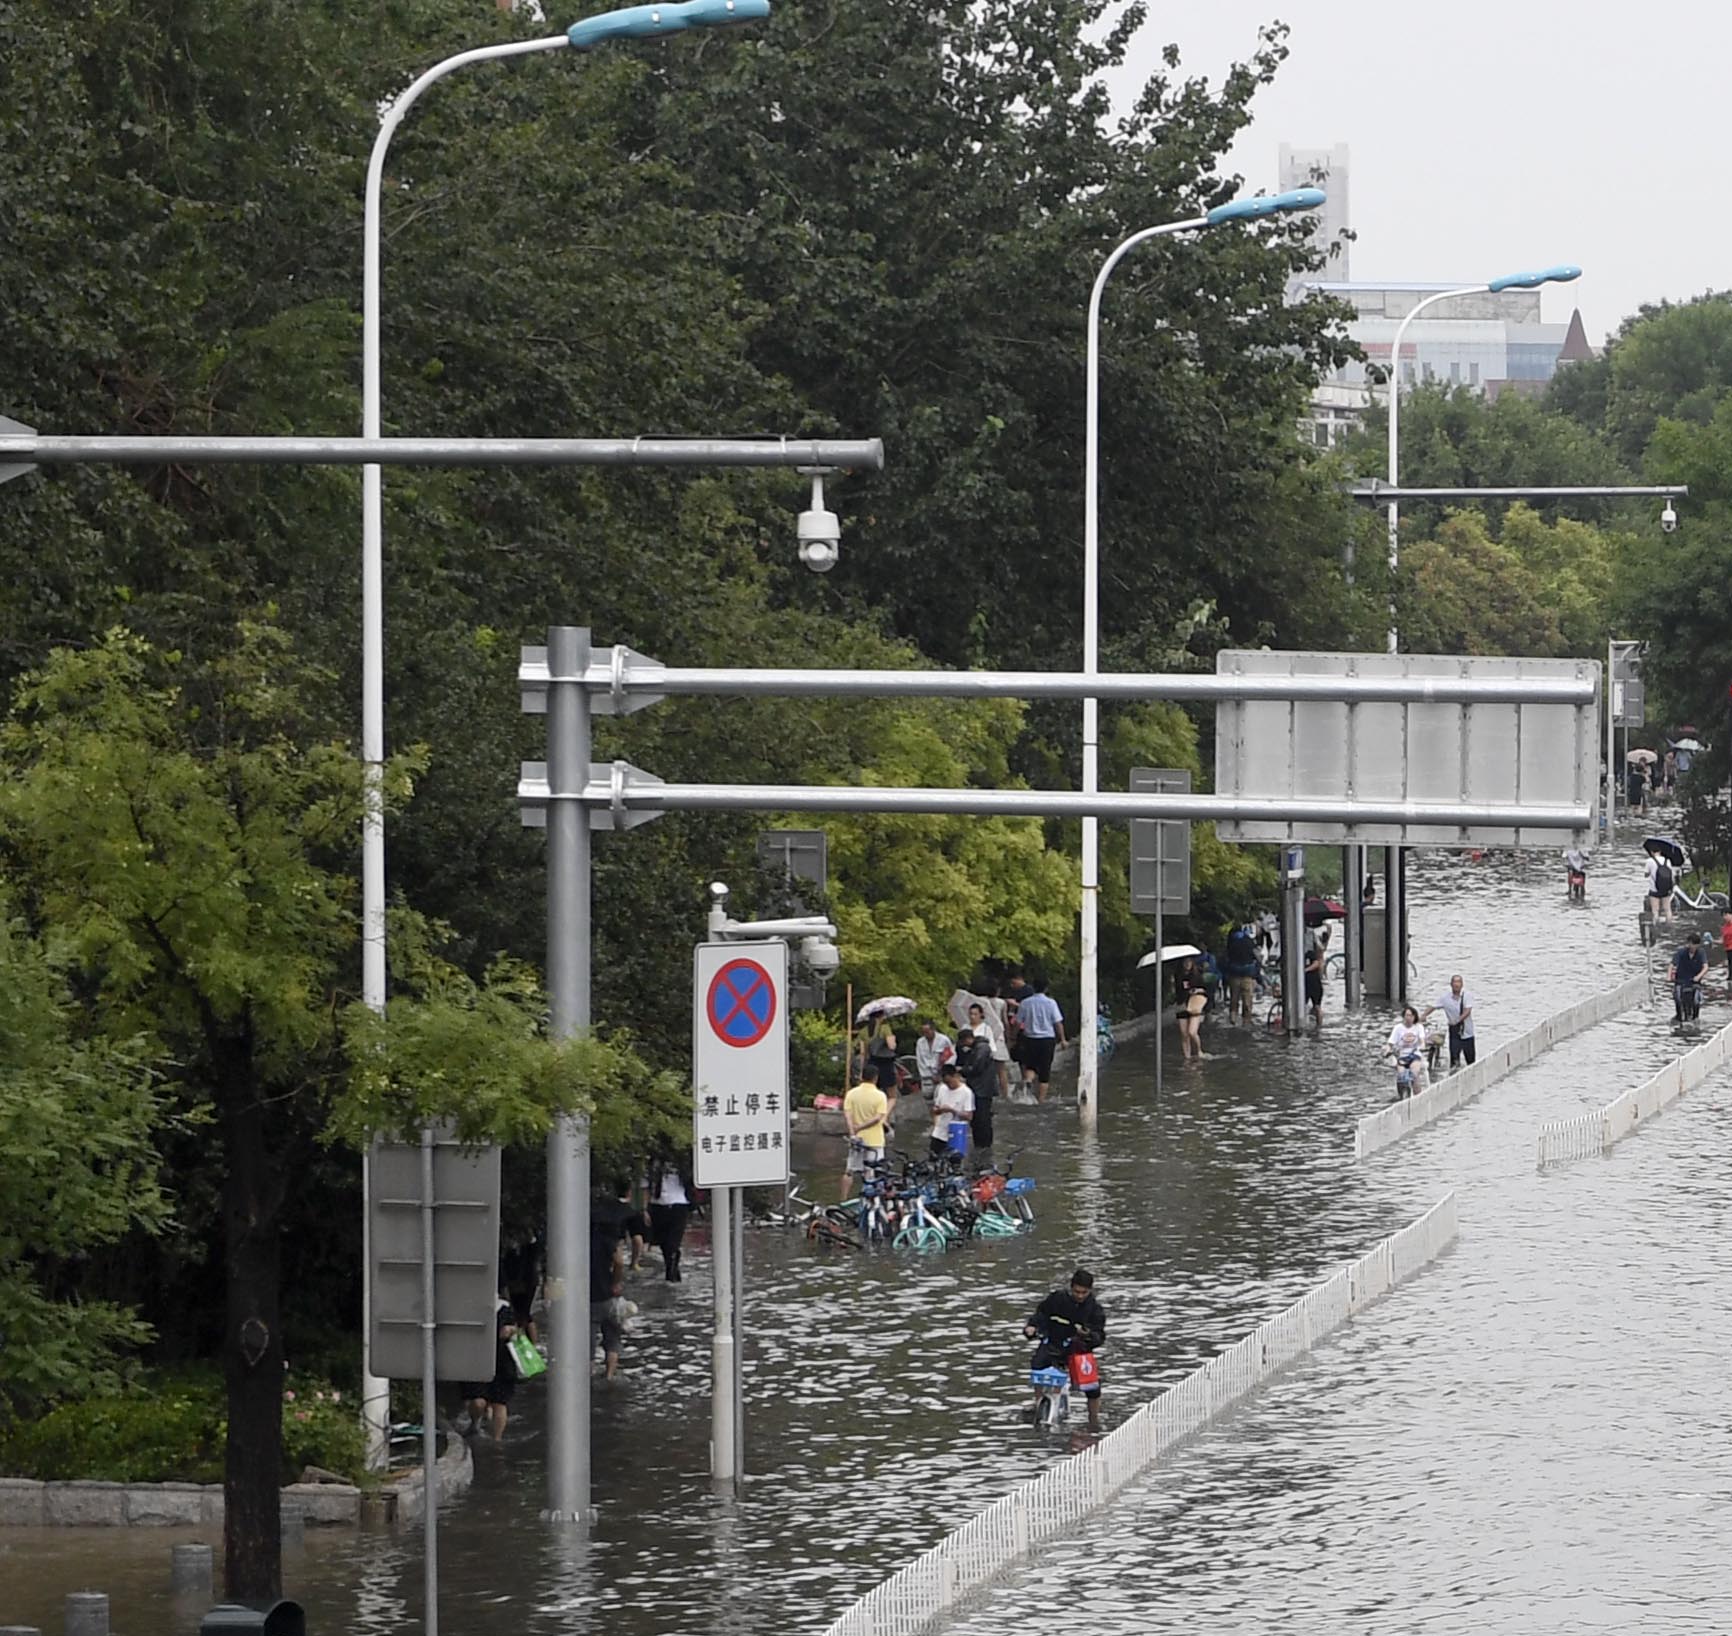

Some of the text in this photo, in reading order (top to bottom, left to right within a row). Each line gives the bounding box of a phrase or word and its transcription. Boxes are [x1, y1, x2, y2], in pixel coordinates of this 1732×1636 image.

[703, 1092, 780, 1118] 禁止停车
[701, 1131, 783, 1153] 电子监控摄录
